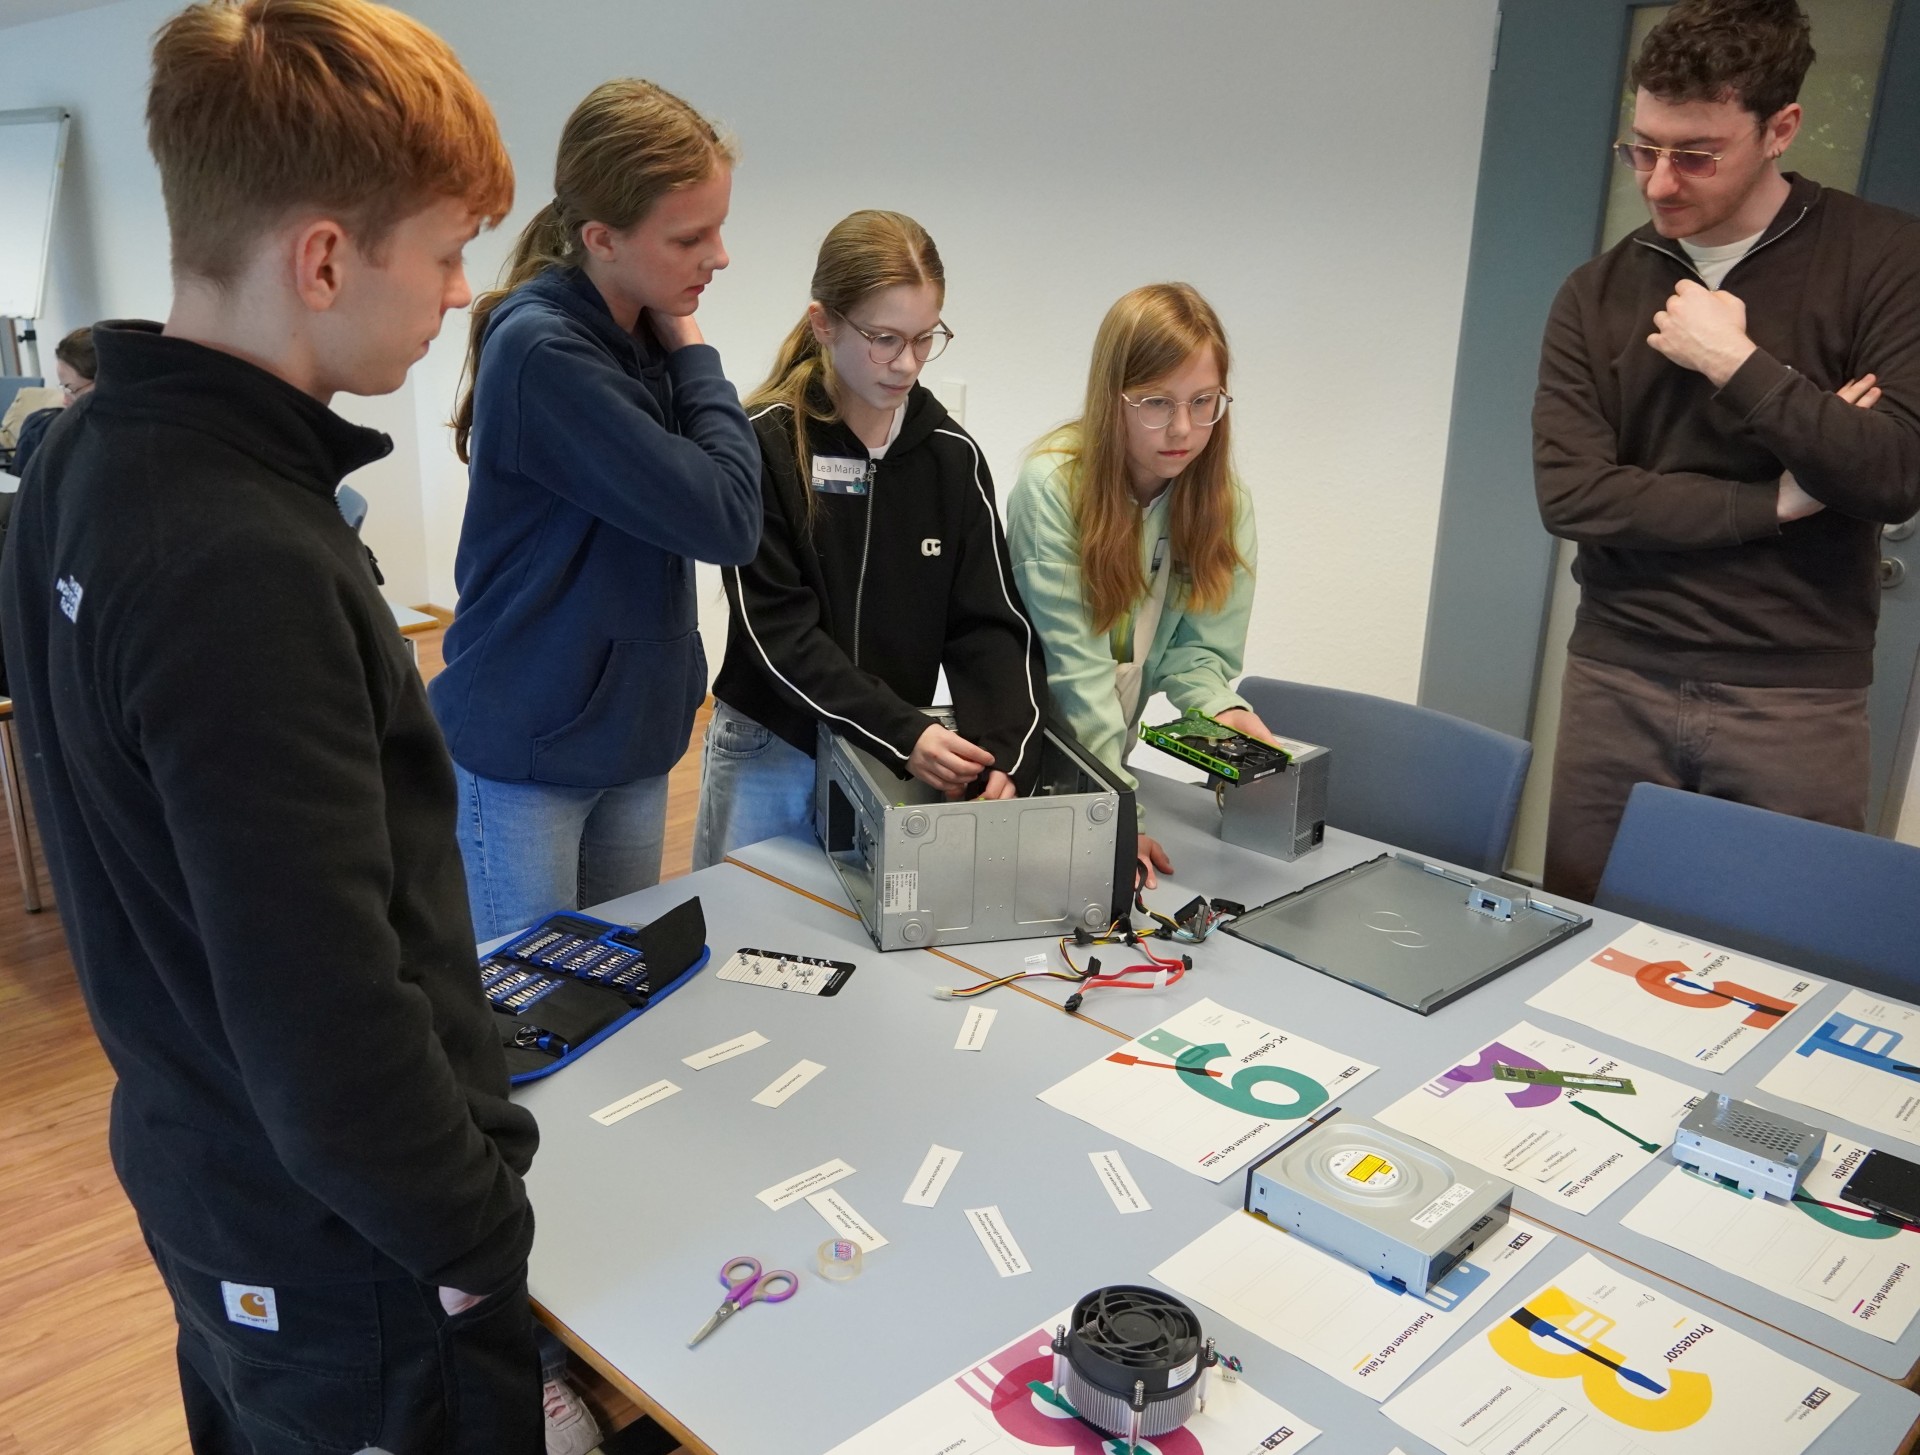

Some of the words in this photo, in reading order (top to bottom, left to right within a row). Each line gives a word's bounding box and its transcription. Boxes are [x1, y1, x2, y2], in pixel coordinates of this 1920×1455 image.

[816, 462, 832, 472] Lea
[834, 464, 861, 474] Maria
[1696, 955, 1730, 977] Grafikkarte
[1635, 960, 1798, 1030] 5
[1720, 1026, 1747, 1047] Funktionen
[1240, 1035, 1288, 1063] PC-Gehäuse
[1700, 1050, 1718, 1062] Teiles
[1712, 1044, 1724, 1054] des
[1233, 1122, 1270, 1147] Funktionen
[1221, 1146, 1235, 1154] des
[1202, 1154, 1226, 1167] Teiles
[1589, 1152, 1624, 1177] Funktionen
[1831, 1148, 1866, 1179] Festplatte
[785, 1180, 805, 1192] ausführt
[805, 1173, 822, 1182] Befehle
[1579, 1175, 1593, 1184] des
[1563, 1184, 1586, 1197] Teiles
[827, 1198, 843, 1212] Schreibt
[840, 1210, 852, 1220] Daten
[974, 1211, 988, 1232] schnelleres
[1005, 1261, 1015, 1273] Daten
[983, 1213, 1000, 1236] Beschleunigt
[1011, 1258, 1021, 1269] durch
[1515, 1234, 1531, 1244] LVR
[1880, 1262, 1910, 1294] Funktionen
[1872, 1292, 1888, 1304] des
[1859, 1302, 1881, 1320] Teiles
[1392, 1312, 1434, 1347] Funktionen
[1379, 1346, 1396, 1358] des
[1663, 1323, 1714, 1363] Prozessor
[1358, 1358, 1385, 1377] Teiles
[1488, 1284, 1713, 1432] 3
[1487, 1386, 1512, 1406] Organisiert
[1810, 1389, 1828, 1402] LVR
[1460, 1403, 1490, 1427] Informationen
[1544, 1406, 1568, 1425] Berechnet
[1271, 1428, 1292, 1442] LVR
[1514, 1428, 1543, 1451] Wesentlichen
[943, 1438, 966, 1453] Schützt
